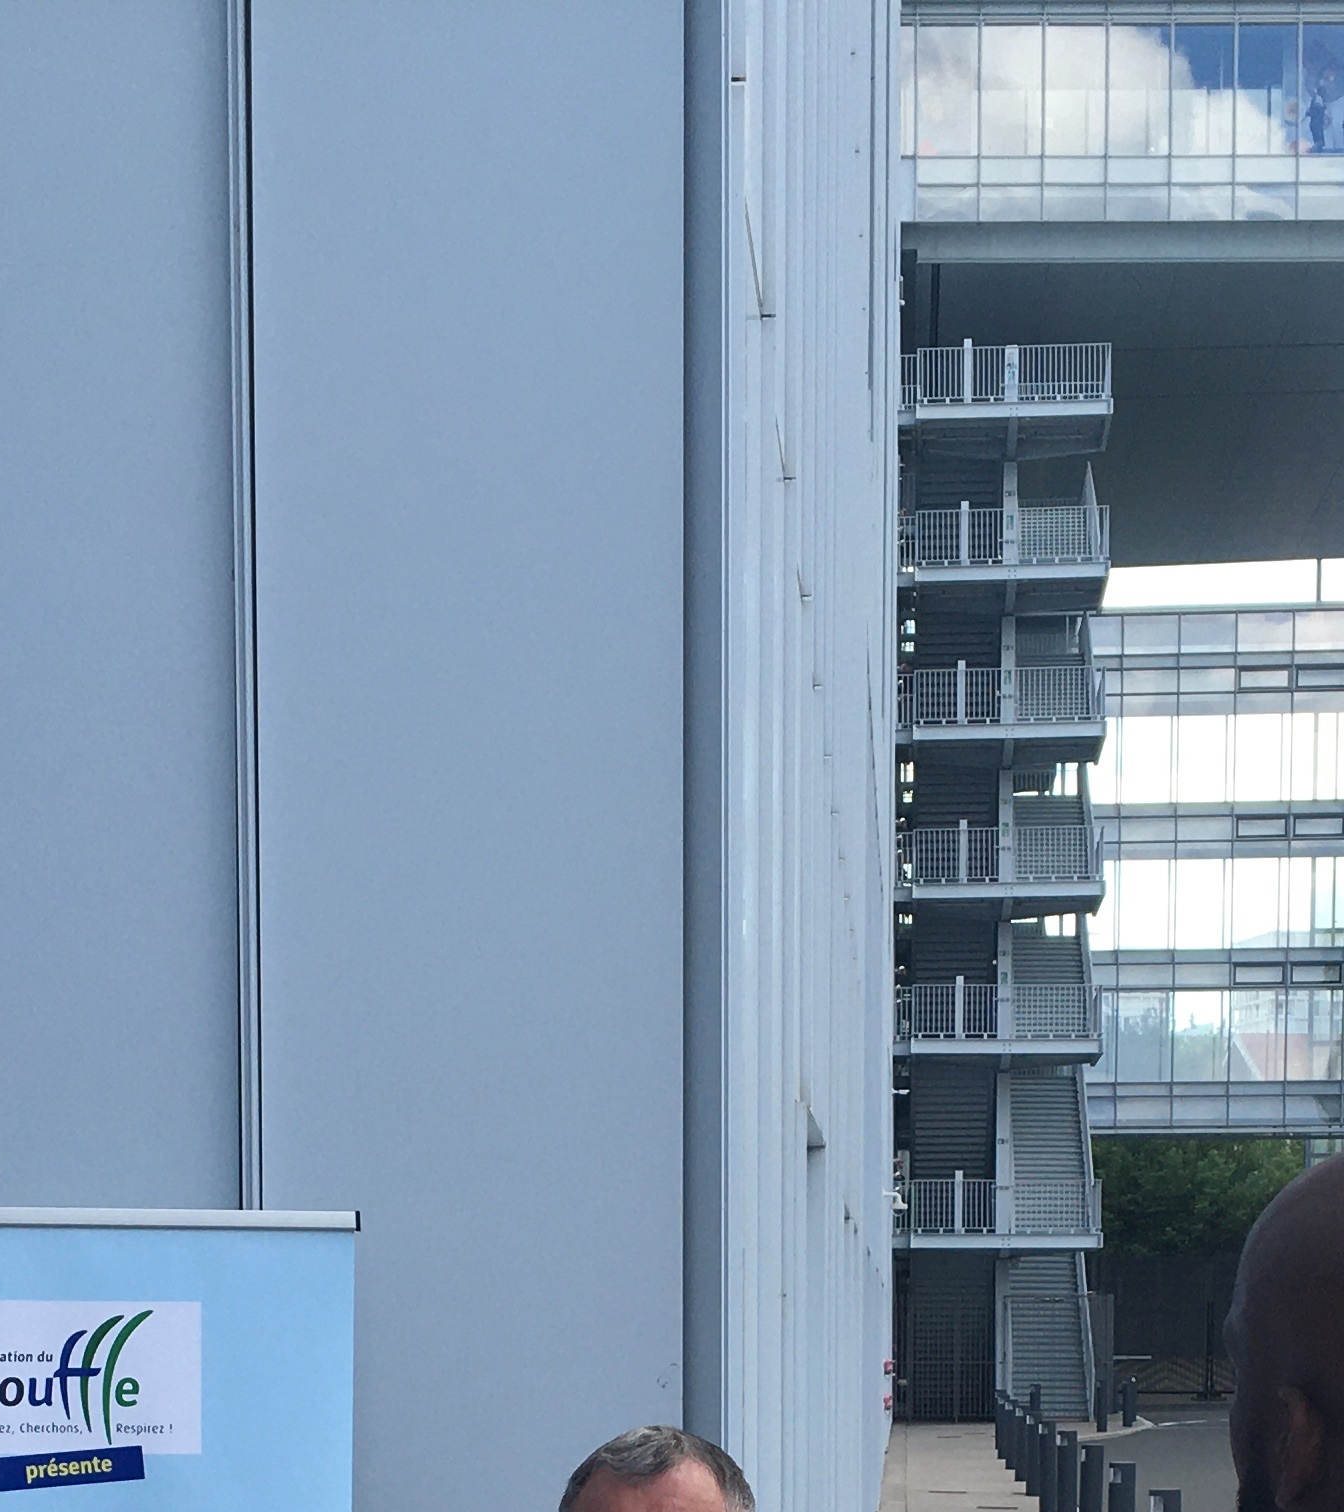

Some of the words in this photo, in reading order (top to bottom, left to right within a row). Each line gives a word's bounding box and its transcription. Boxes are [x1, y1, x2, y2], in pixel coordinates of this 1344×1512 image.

[37, 1350, 54, 1363] du
[19, 1421, 83, 1436] Cherchons,
[115, 1422, 165, 1436] Respirez
[24, 1454, 113, 1484] présente
